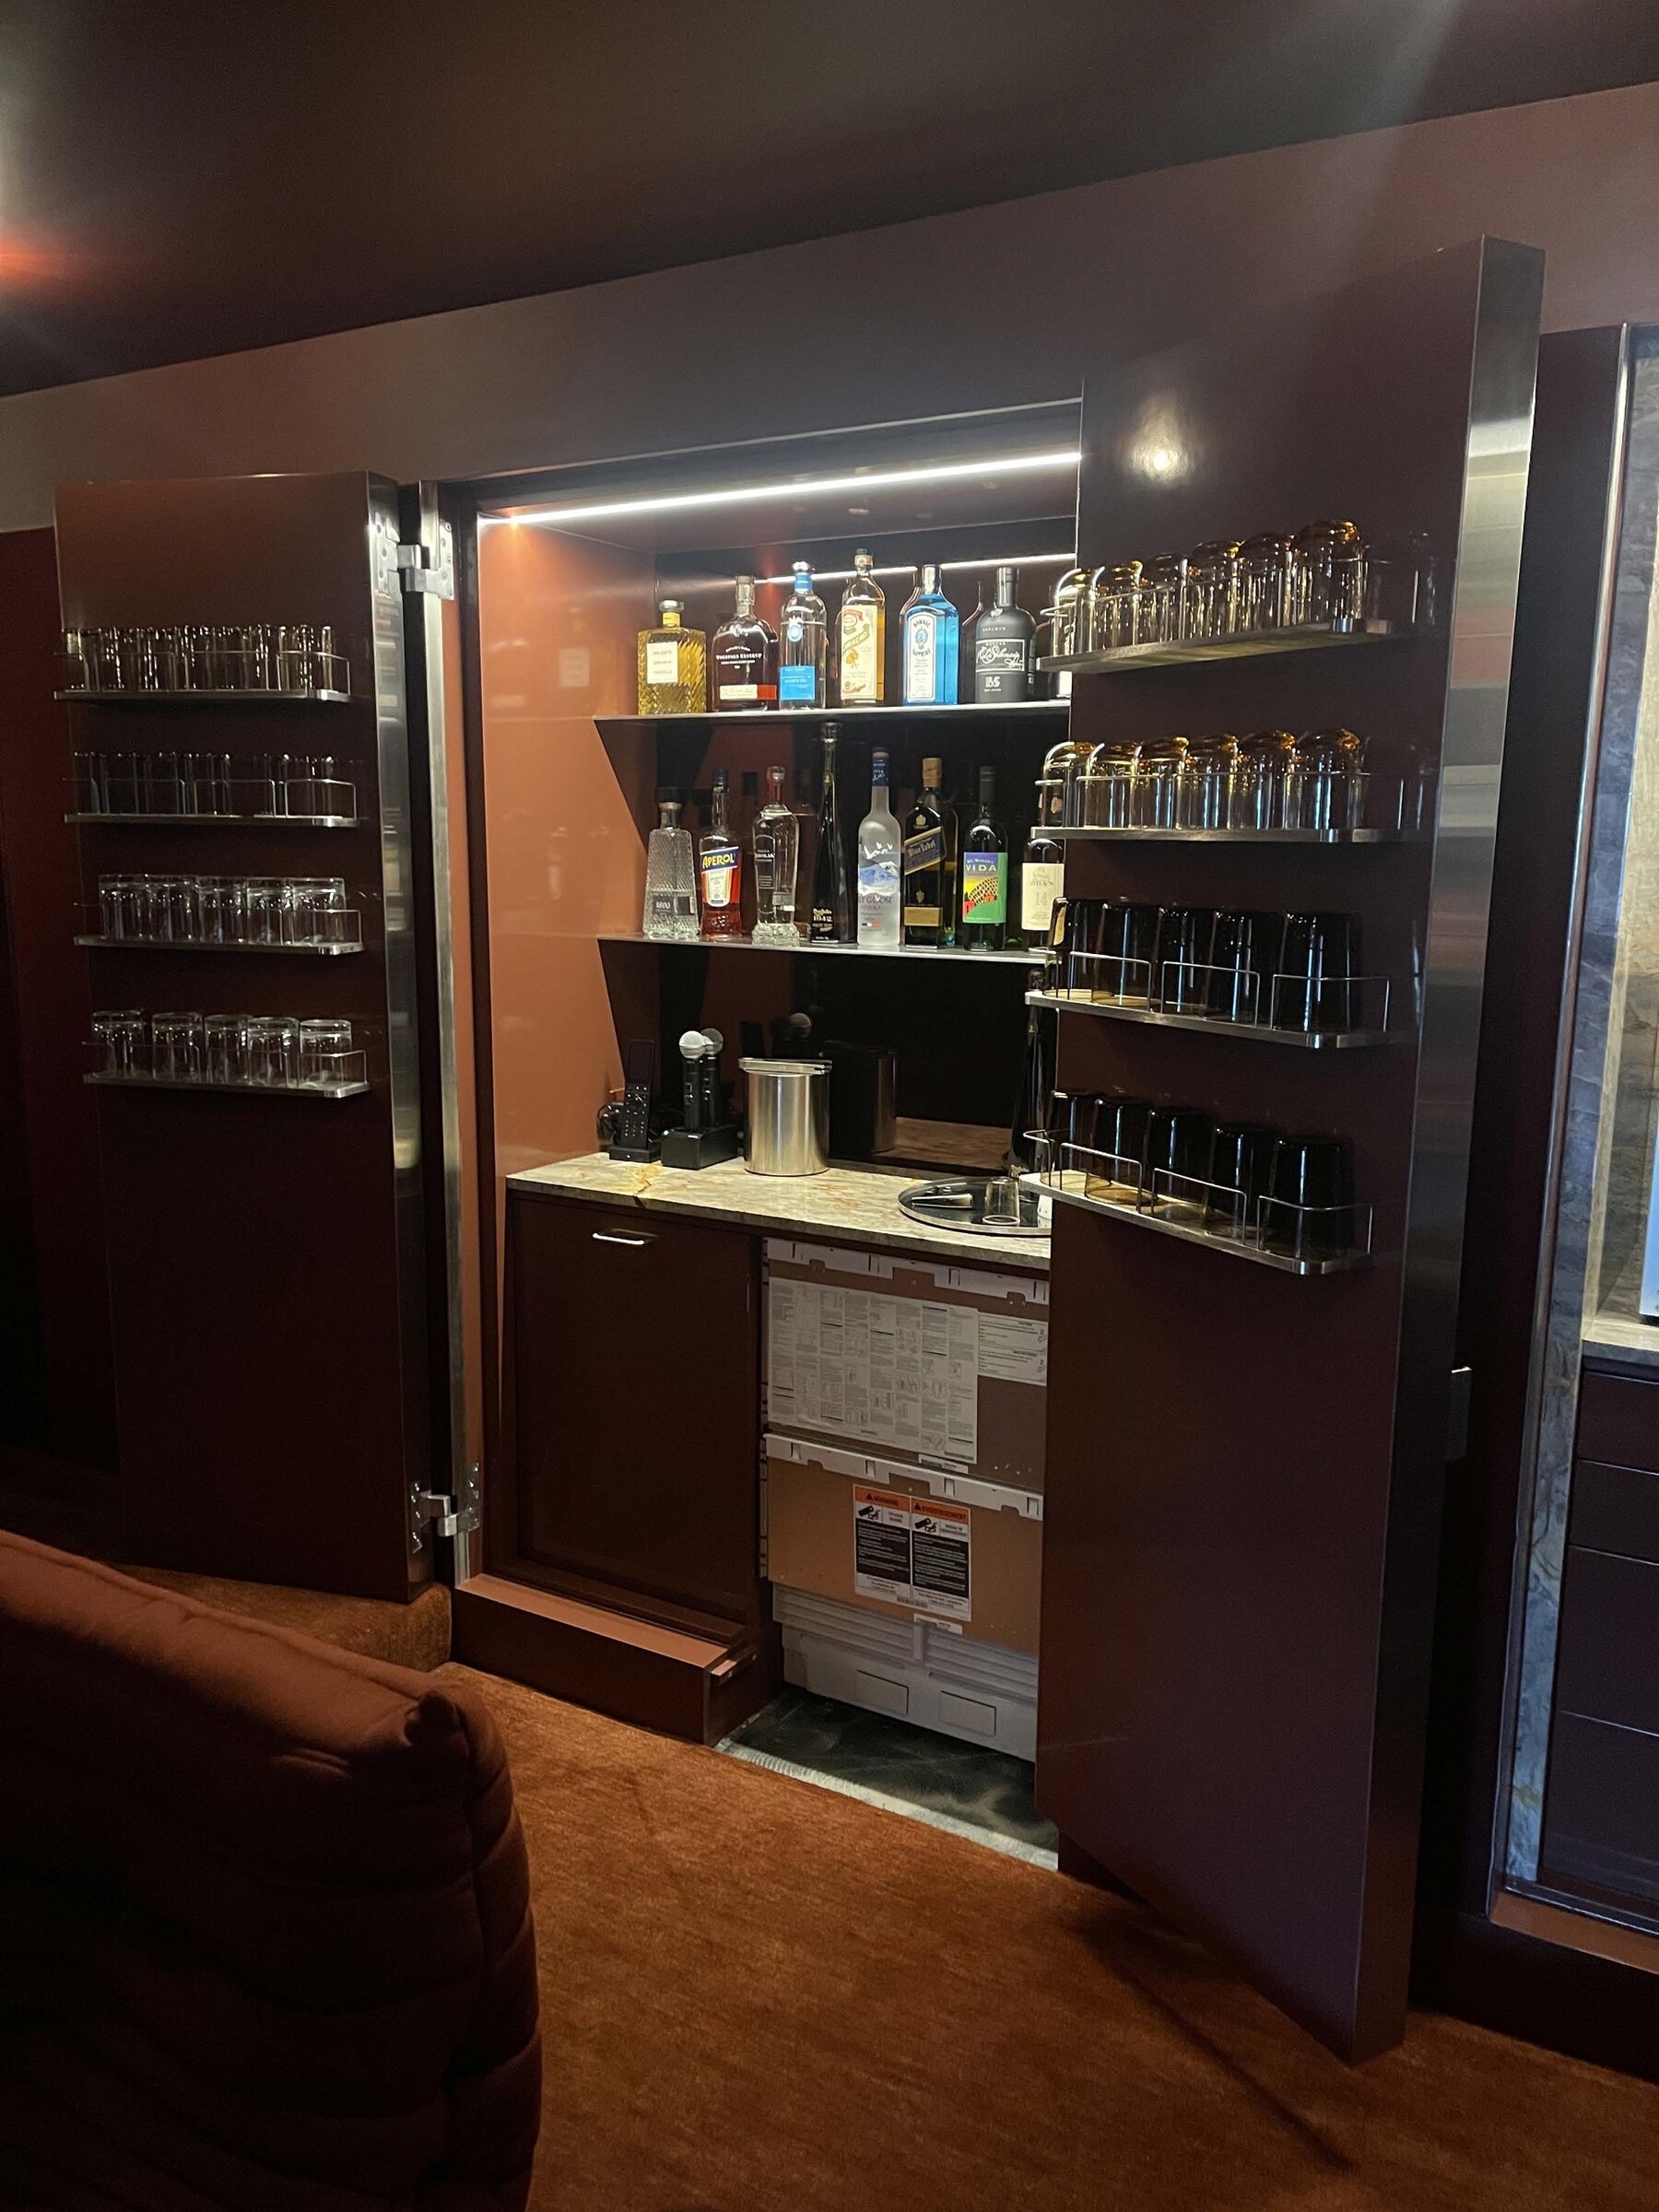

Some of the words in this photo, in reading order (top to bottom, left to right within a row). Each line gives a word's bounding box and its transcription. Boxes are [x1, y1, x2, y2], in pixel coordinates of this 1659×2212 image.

[702, 853, 735, 869] APEROL
[965, 864, 997, 872] VIDA
[1035, 891, 1049, 906] 14
